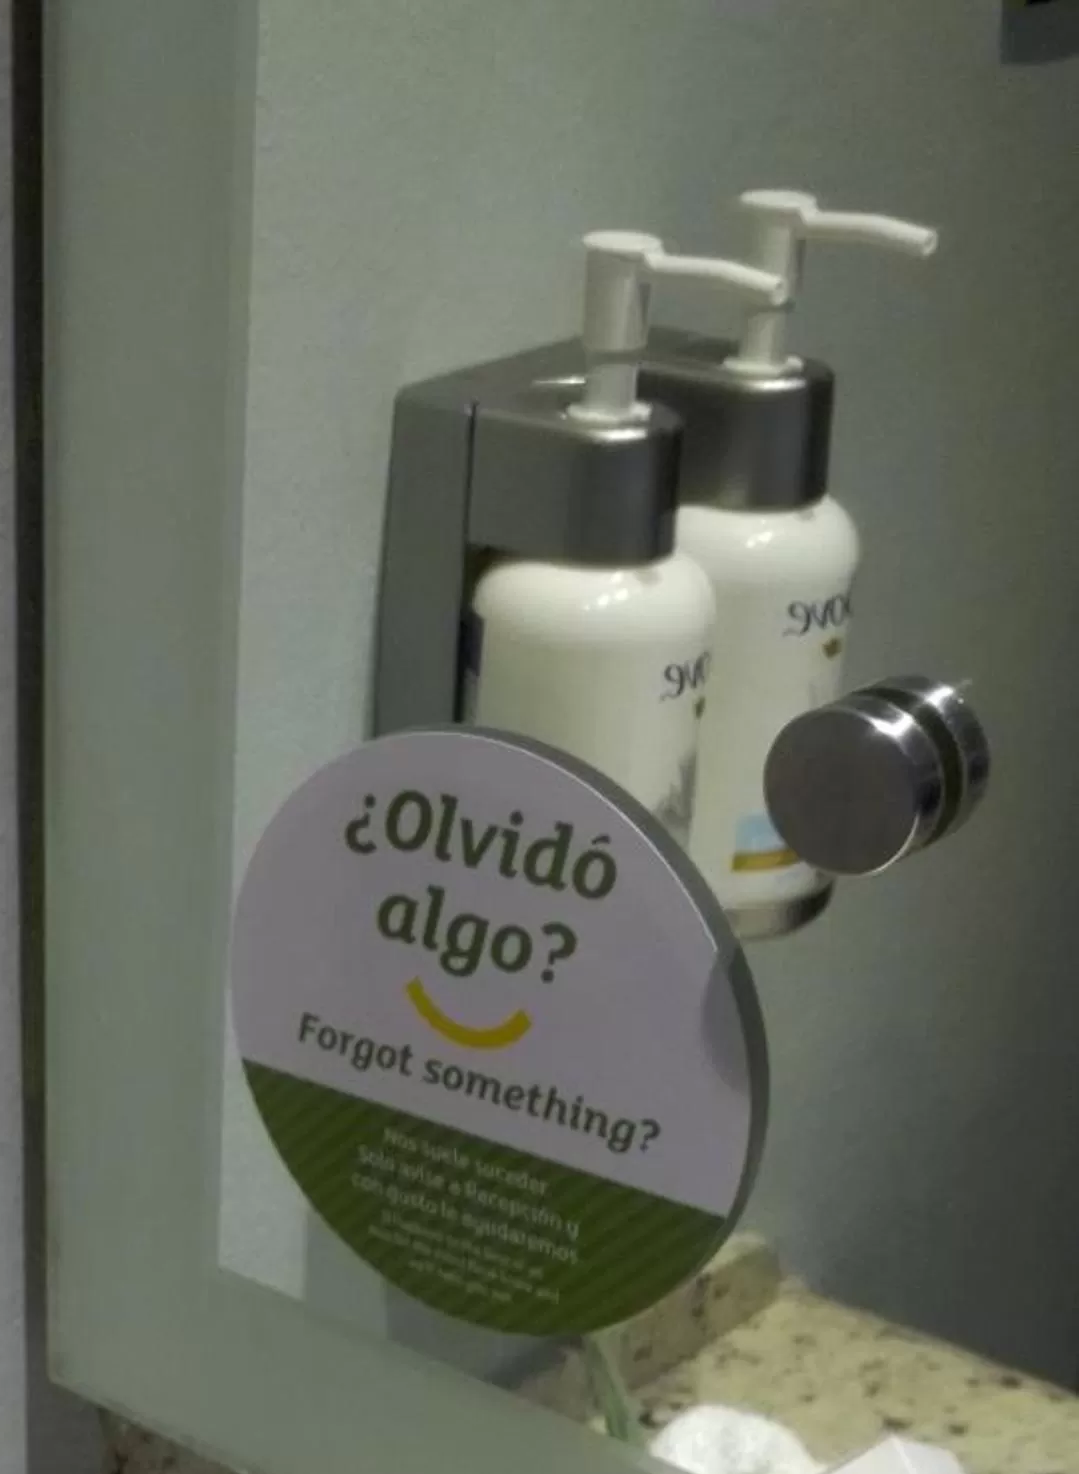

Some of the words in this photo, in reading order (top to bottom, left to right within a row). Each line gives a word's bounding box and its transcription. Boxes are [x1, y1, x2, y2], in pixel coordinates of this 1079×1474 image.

[344, 790, 617, 900] ¿Olvidó
[377, 885, 577, 983] algo?
[298, 1012, 413, 1075] Forgot
[423, 1057, 661, 1153] something?
